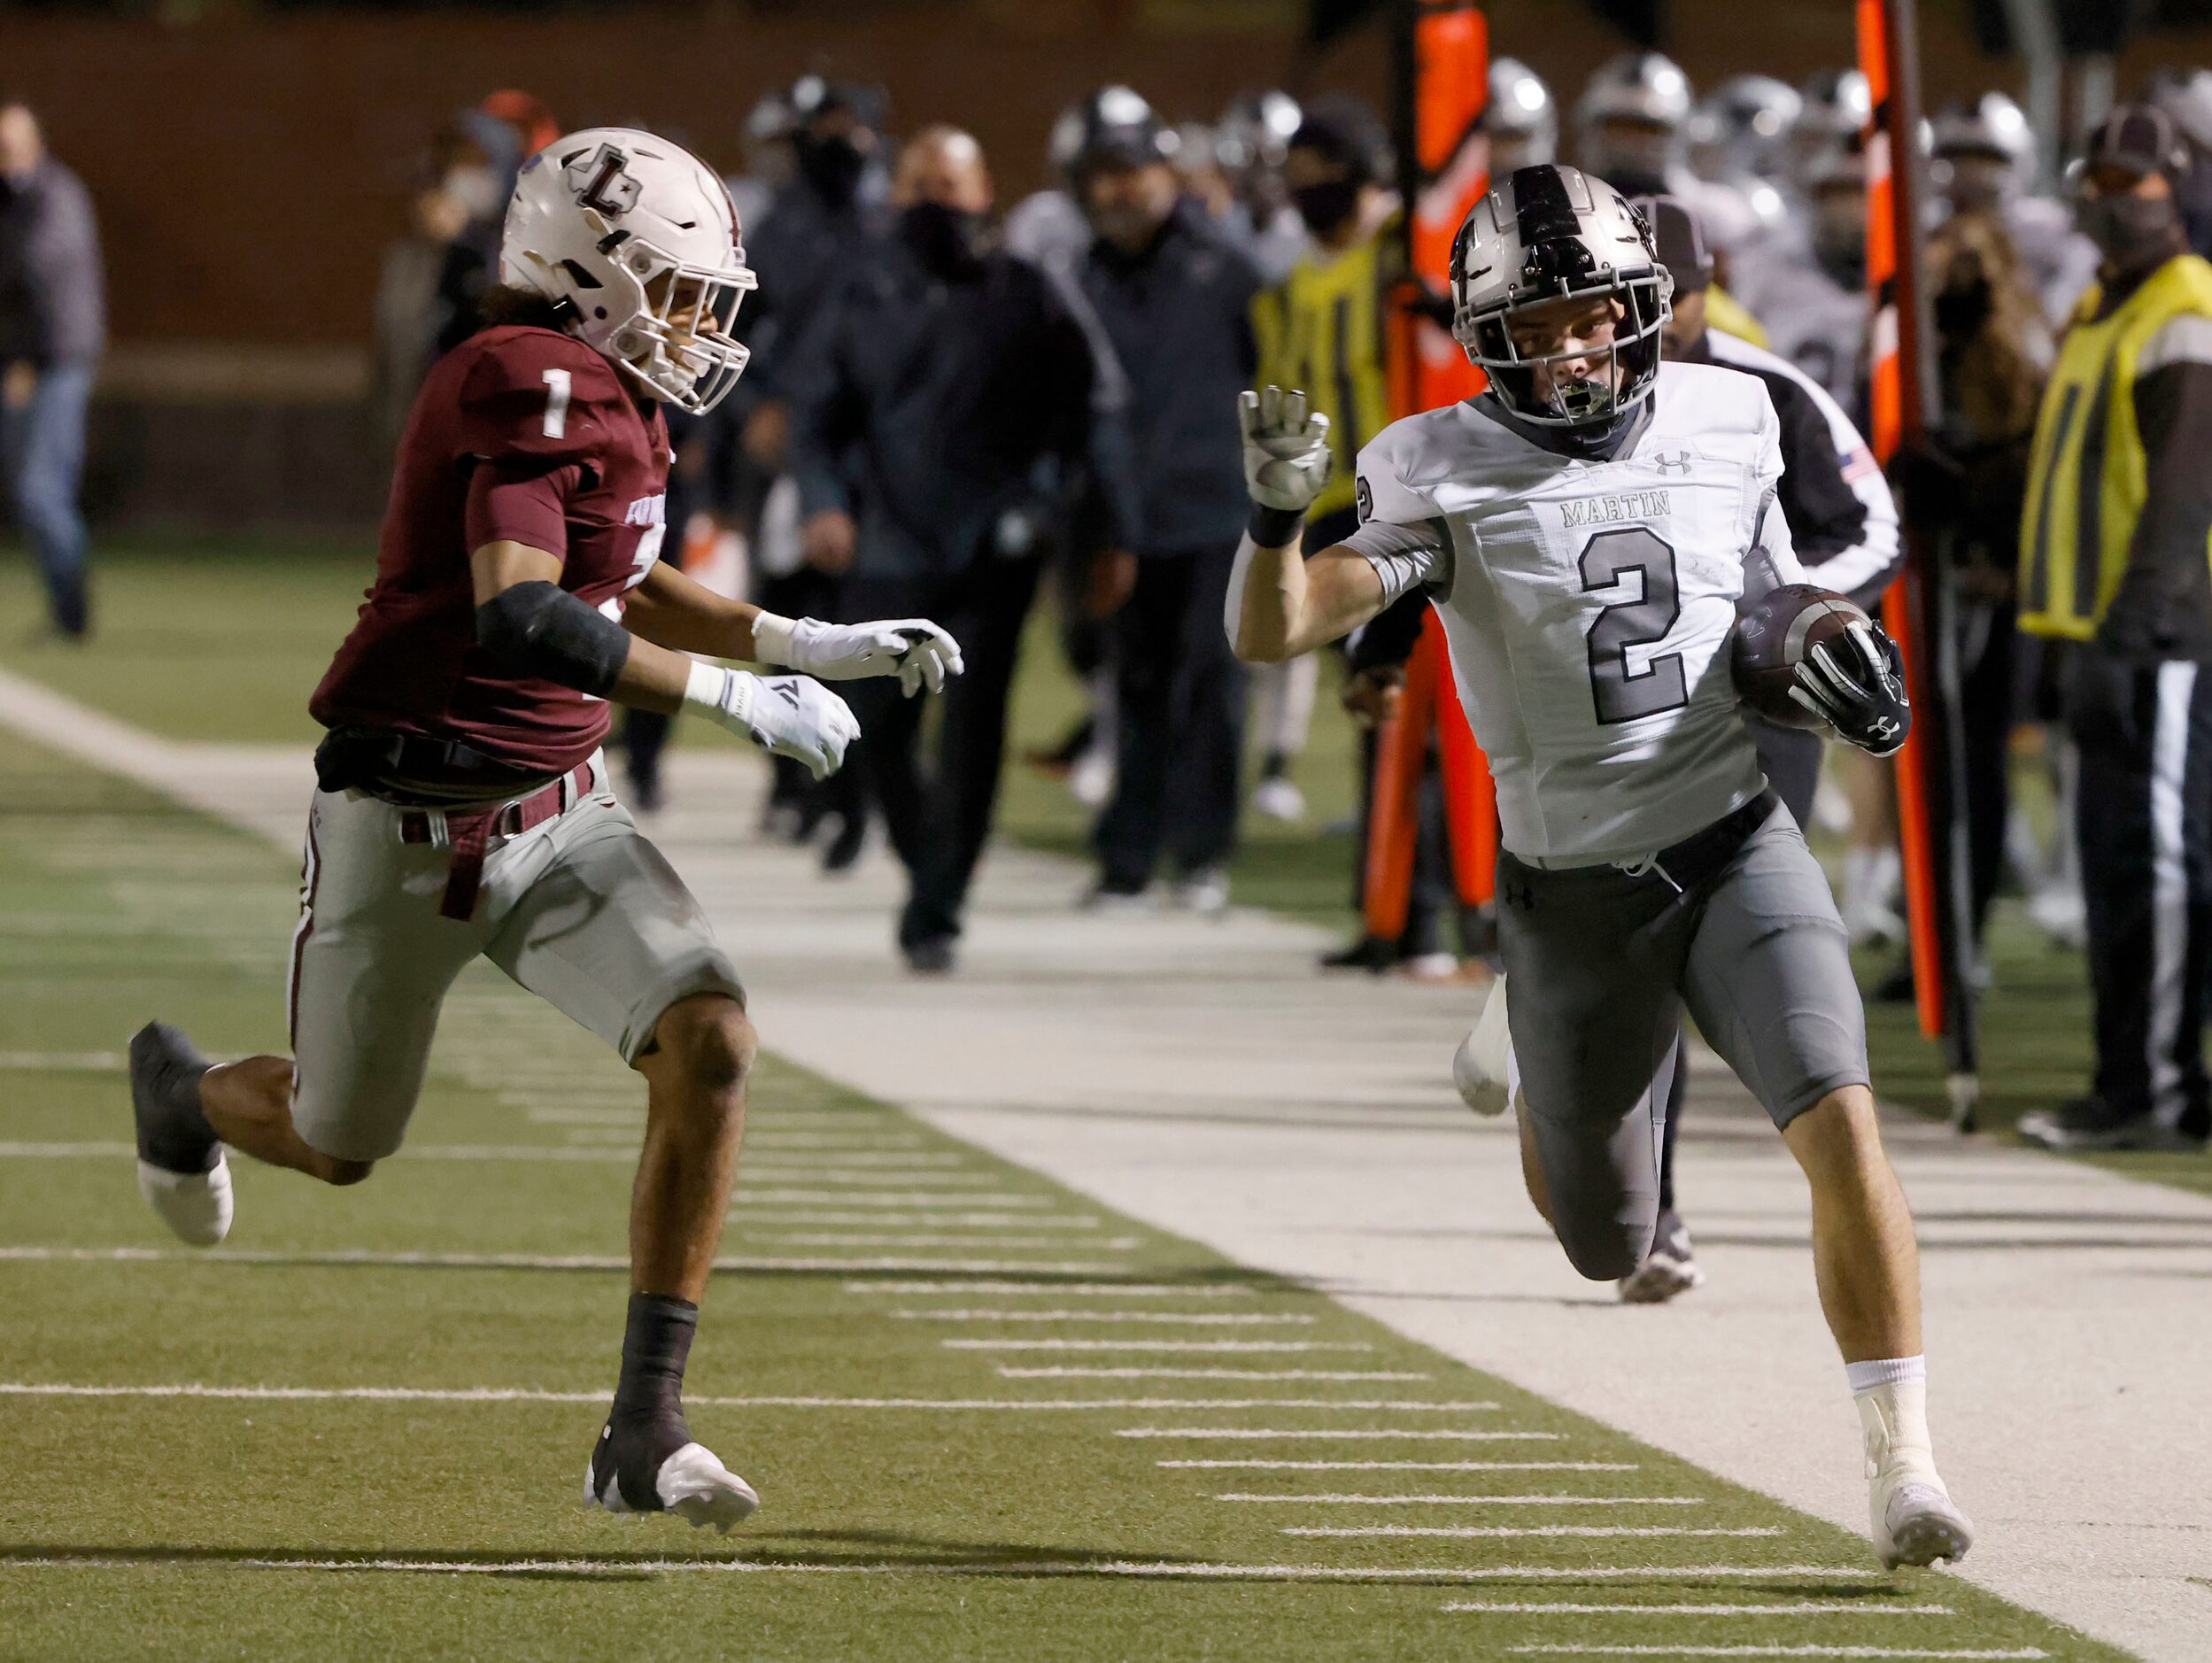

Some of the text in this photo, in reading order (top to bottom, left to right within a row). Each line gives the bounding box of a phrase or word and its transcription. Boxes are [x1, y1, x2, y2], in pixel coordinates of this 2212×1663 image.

[576, 143, 628, 220] L
[542, 368, 571, 440] 1
[1560, 490, 1672, 529] MARTIN
[1578, 527, 1690, 725] 2
